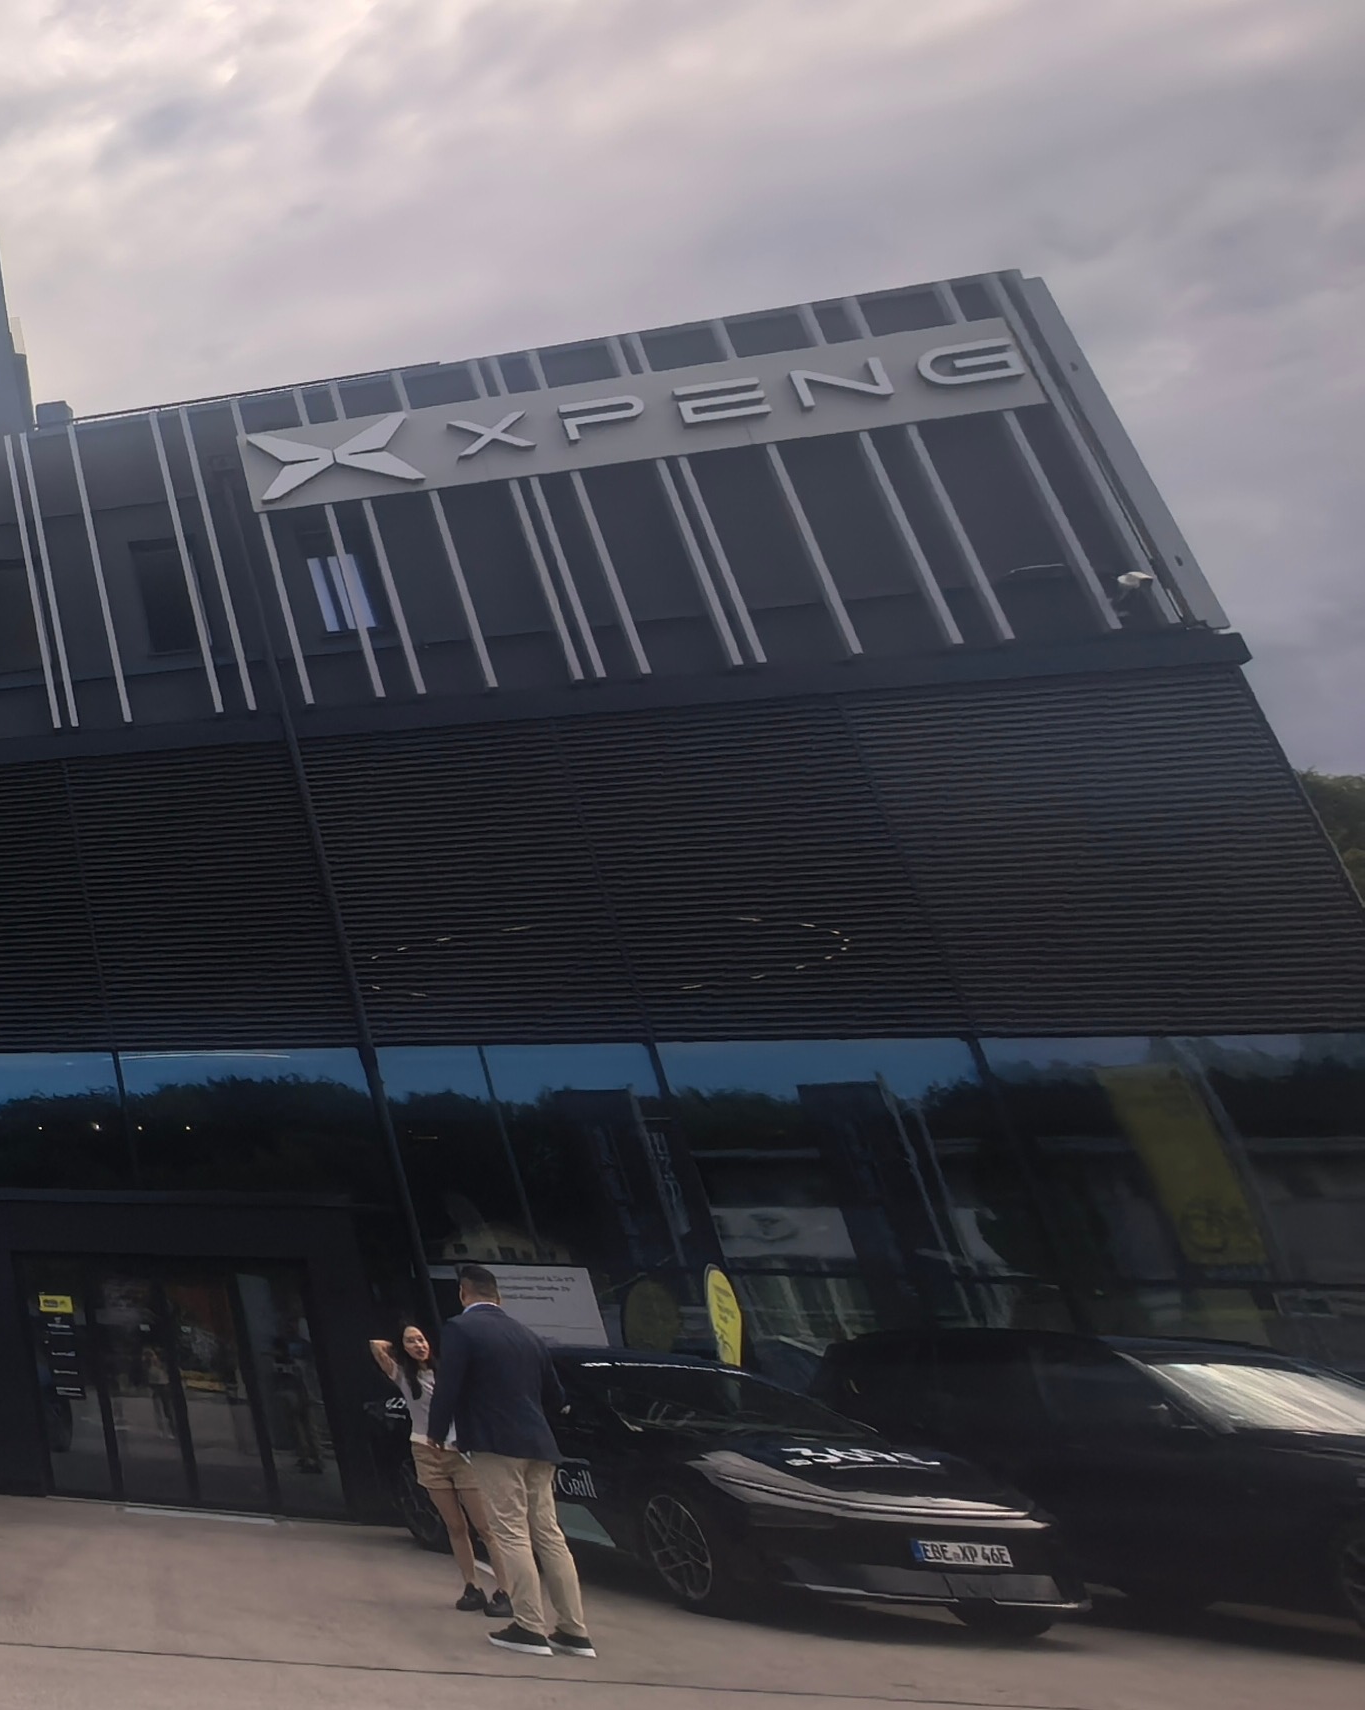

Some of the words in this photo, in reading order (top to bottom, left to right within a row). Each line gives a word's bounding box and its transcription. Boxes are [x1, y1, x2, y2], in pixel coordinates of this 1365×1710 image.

[446, 337, 1027, 464] XPENG
[922, 1543, 953, 1561] EBE
[957, 1544, 978, 1563] XP
[981, 1545, 1011, 1564] 46E
